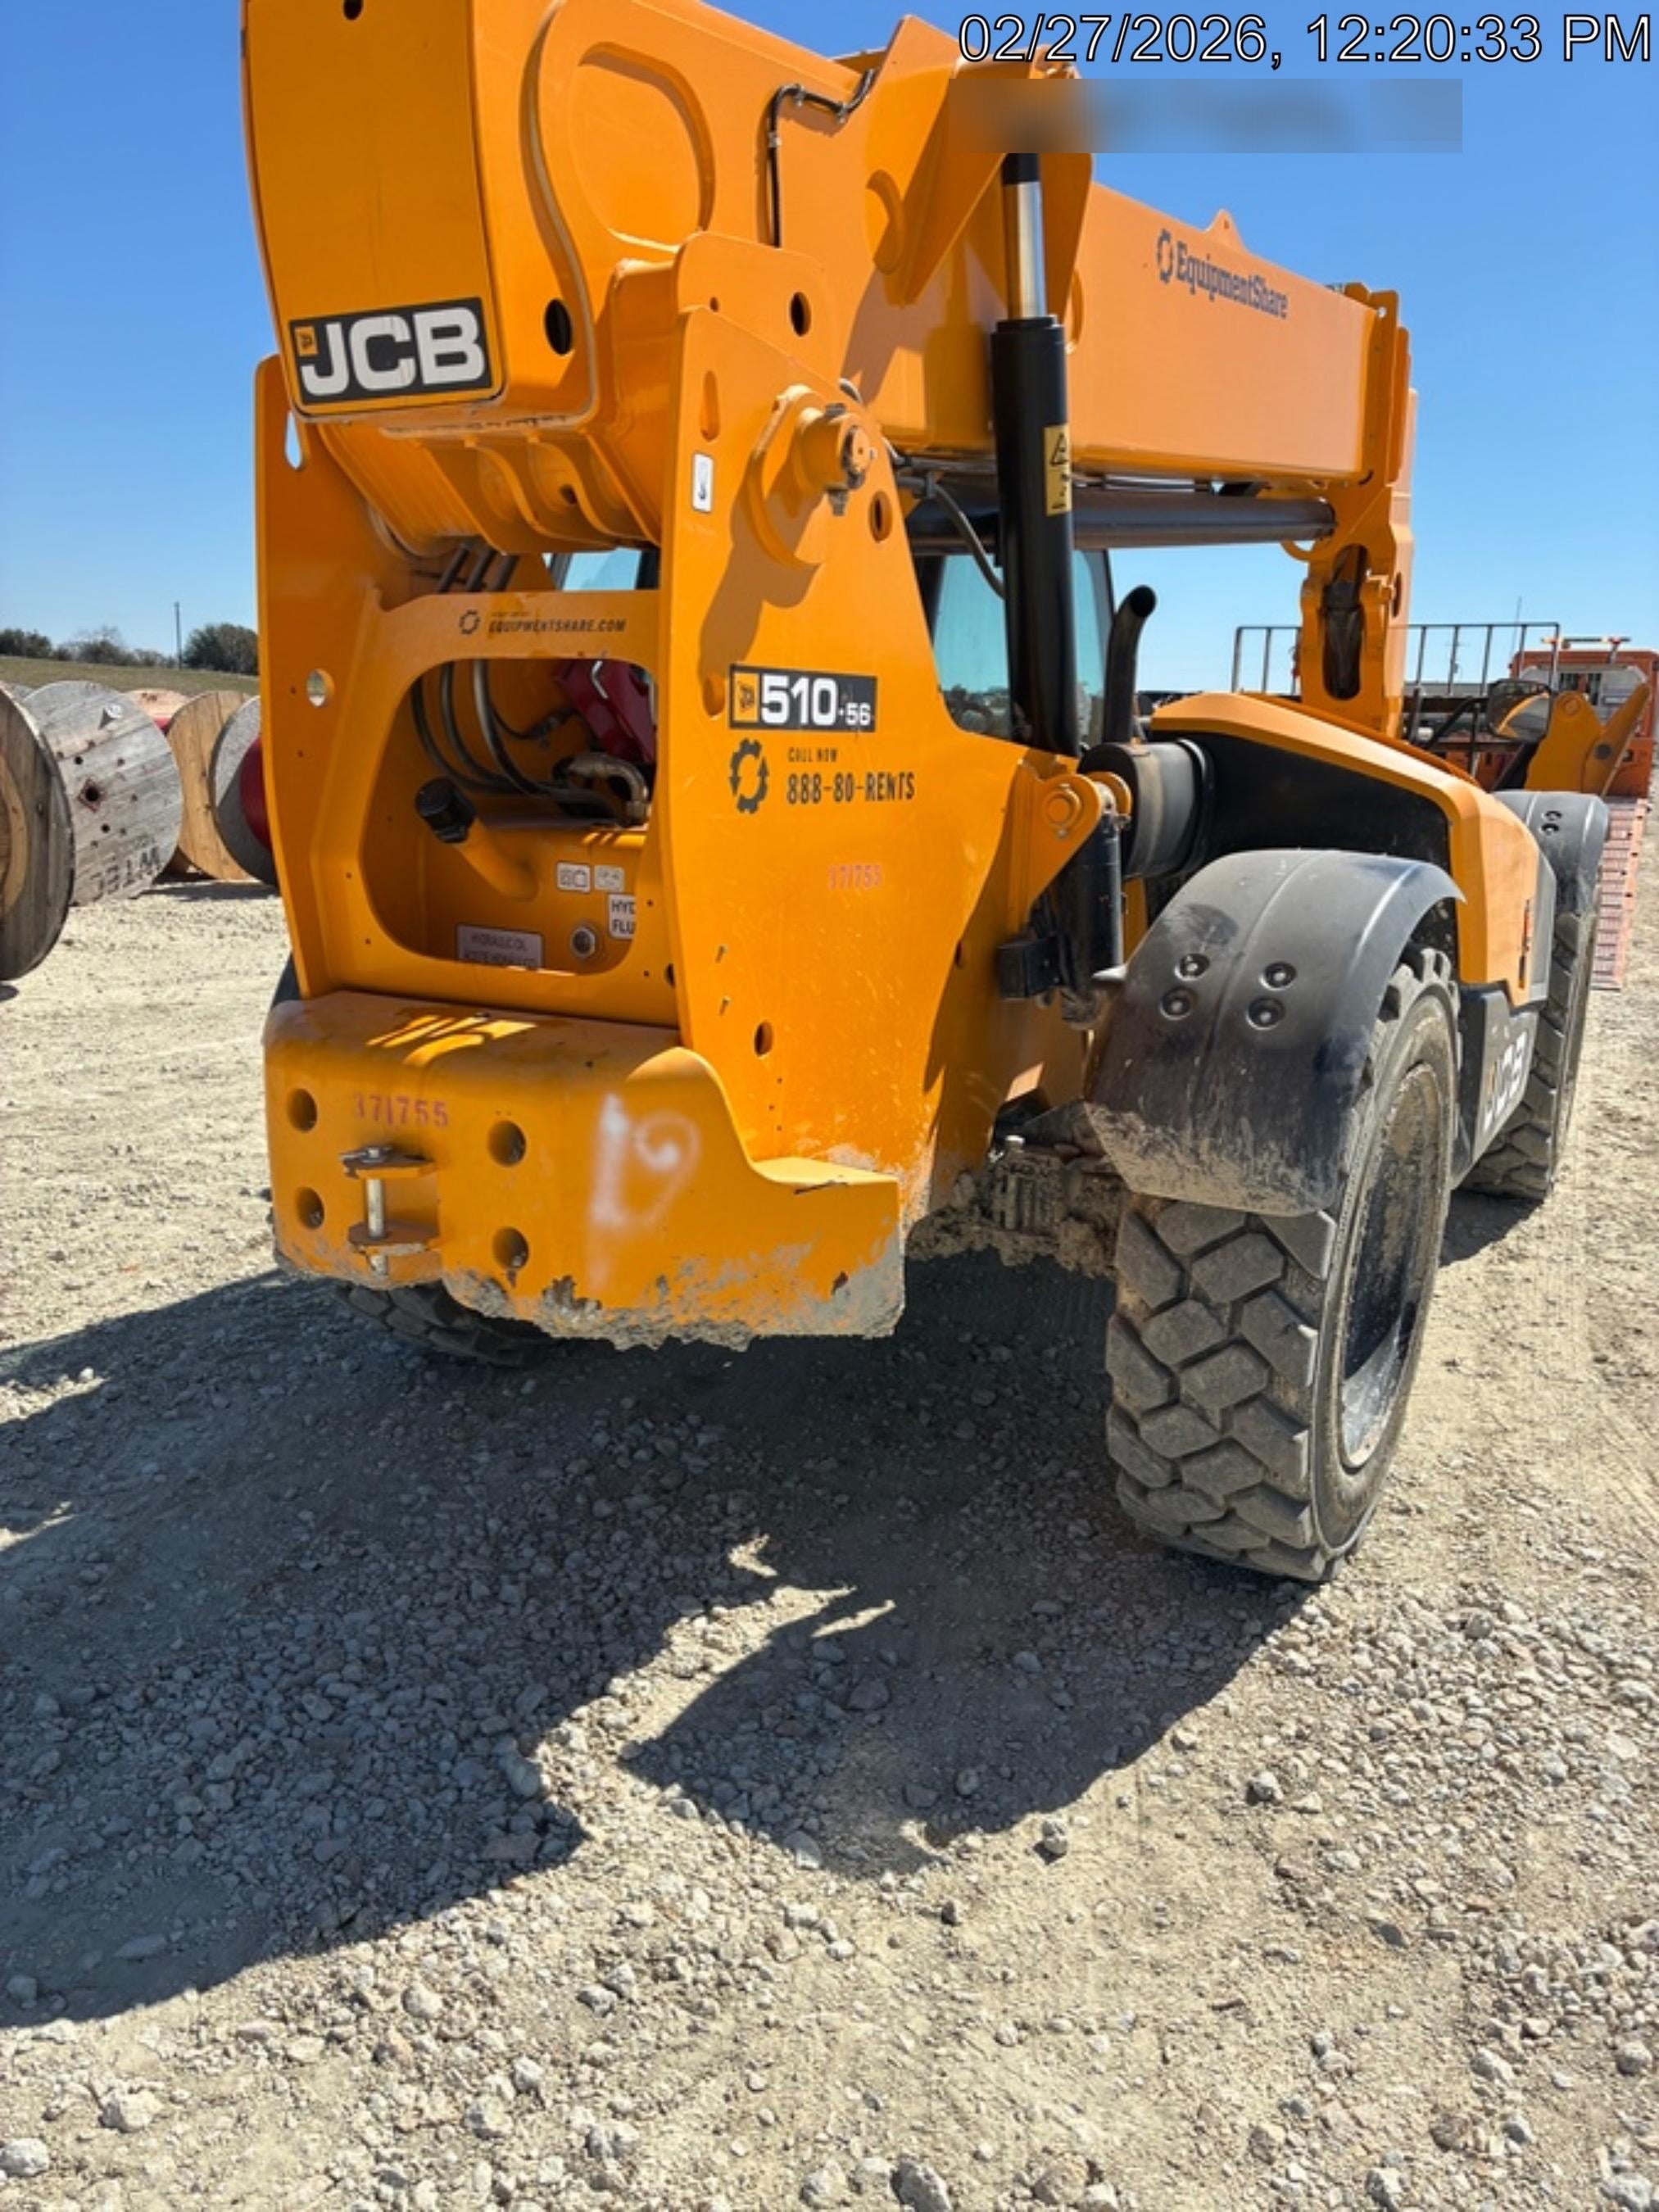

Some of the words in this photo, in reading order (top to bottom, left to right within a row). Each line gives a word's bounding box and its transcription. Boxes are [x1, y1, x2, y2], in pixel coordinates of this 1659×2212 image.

[1176, 241, 1289, 319] EquipmentShare
[300, 306, 485, 397] JCB
[787, 747, 814, 763] CALL
[817, 748, 838, 763] NOW
[786, 772, 916, 805] 888-80-RENTS
